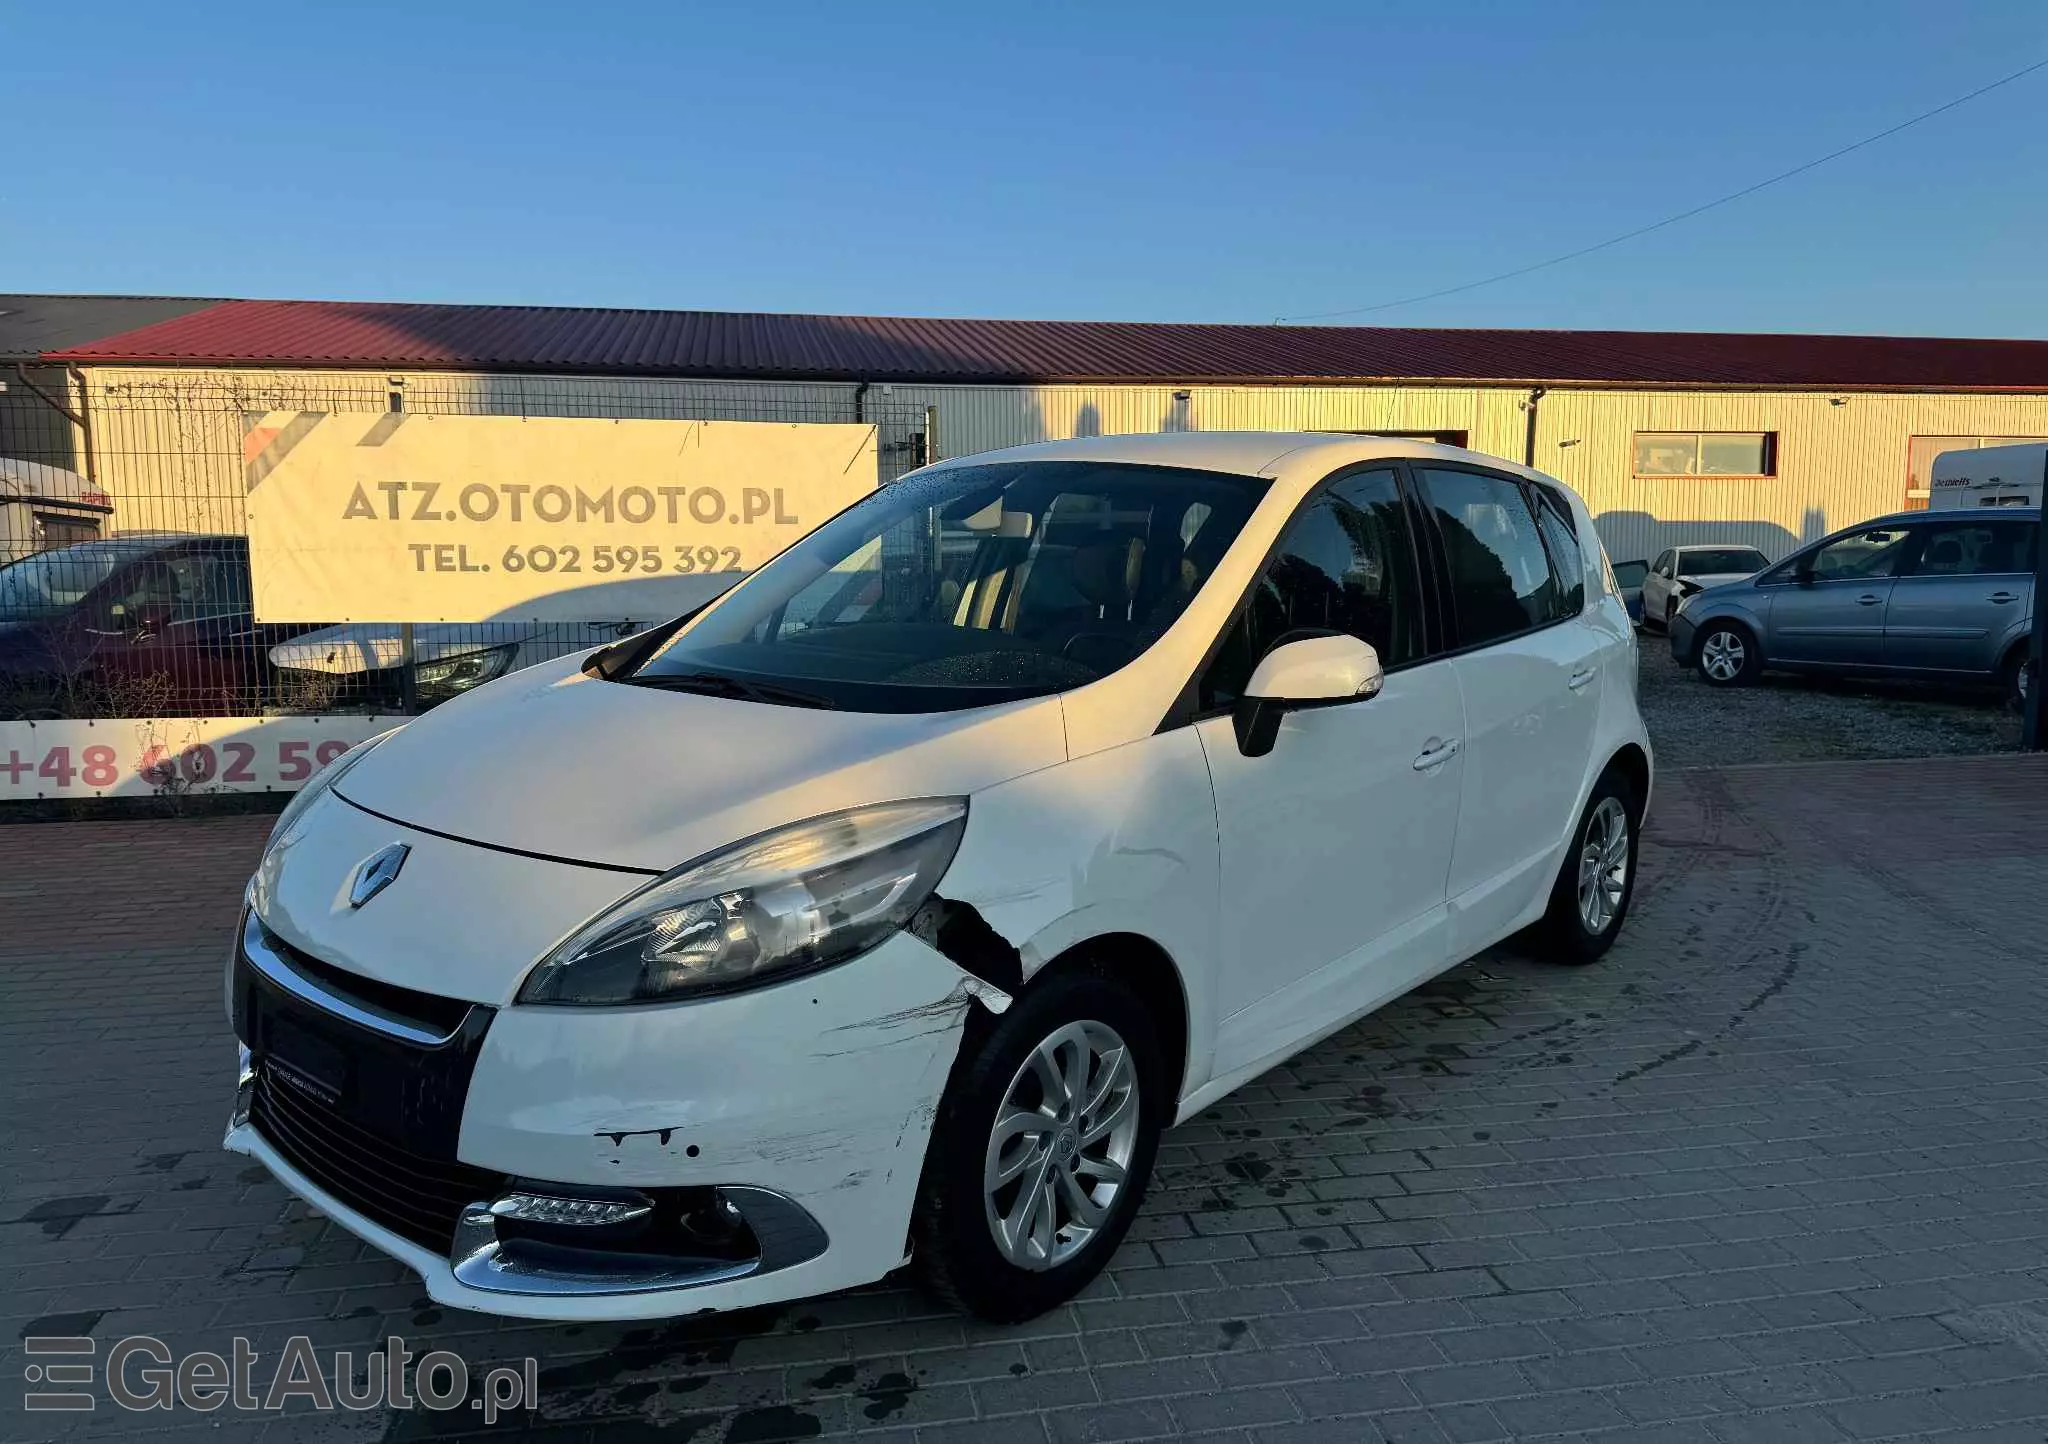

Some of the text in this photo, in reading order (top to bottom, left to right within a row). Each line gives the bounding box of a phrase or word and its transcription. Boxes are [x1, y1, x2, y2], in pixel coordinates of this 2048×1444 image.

[342, 481, 799, 525] ATZ.OTOMOTO.PL
[407, 543, 743, 574] TEL. 602 595 392
[0, 744, 119, 788] +48
[139, 742, 257, 786] 602
